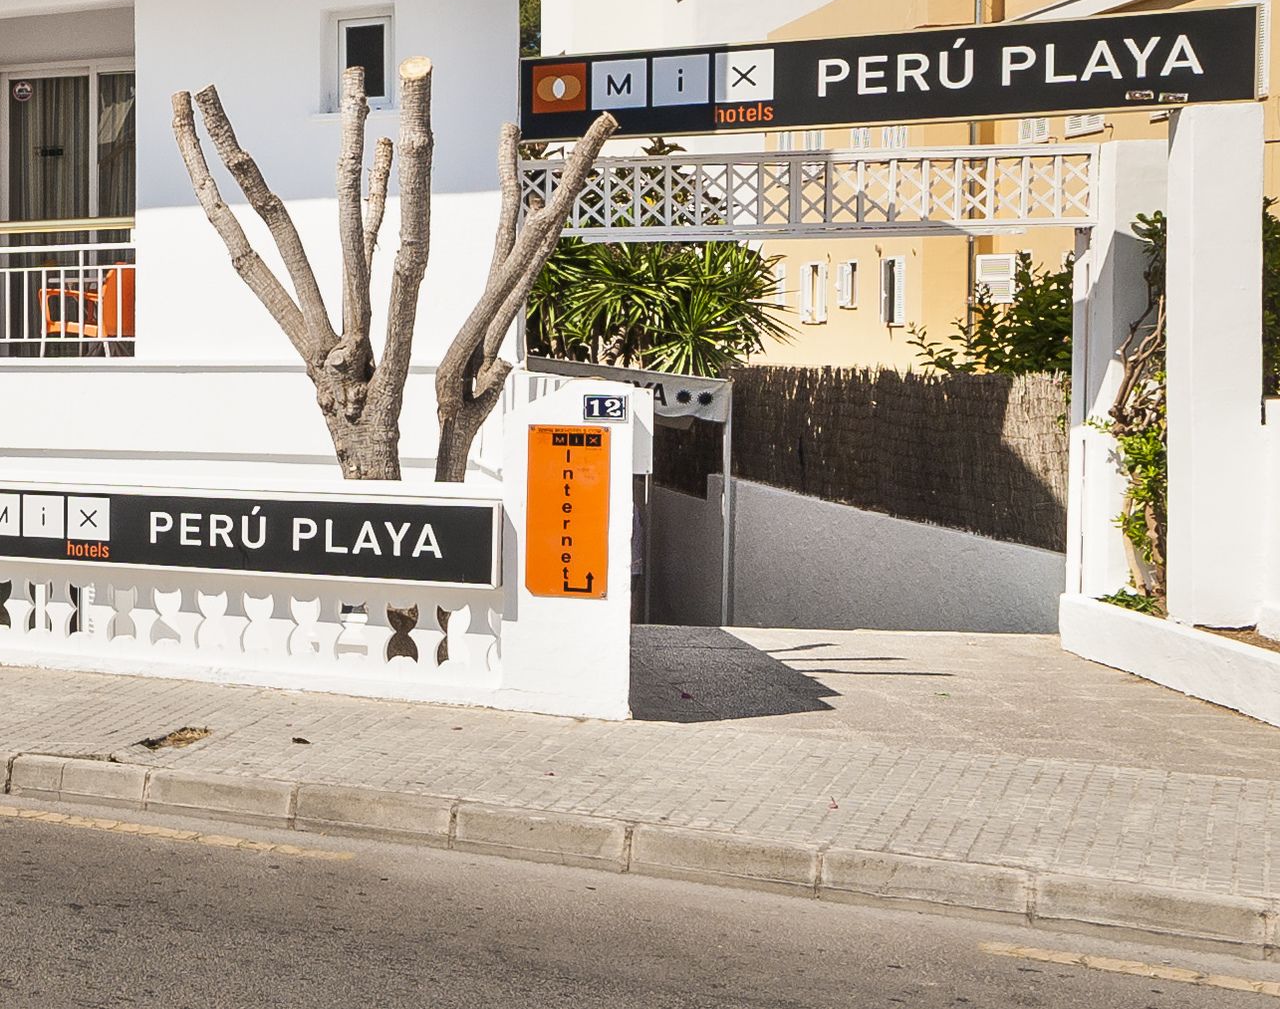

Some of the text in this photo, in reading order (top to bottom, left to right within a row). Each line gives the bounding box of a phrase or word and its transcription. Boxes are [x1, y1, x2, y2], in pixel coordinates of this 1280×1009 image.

[817, 37, 974, 98] PERÚ
[1001, 34, 1204, 87] PLAYA
[715, 102, 774, 124] hotels
[589, 398, 622, 417] 12
[149, 505, 267, 549] PERÚ
[292, 517, 443, 559] PLAYA
[561, 449, 574, 580] Internet
[67, 541, 110, 559] hotels
